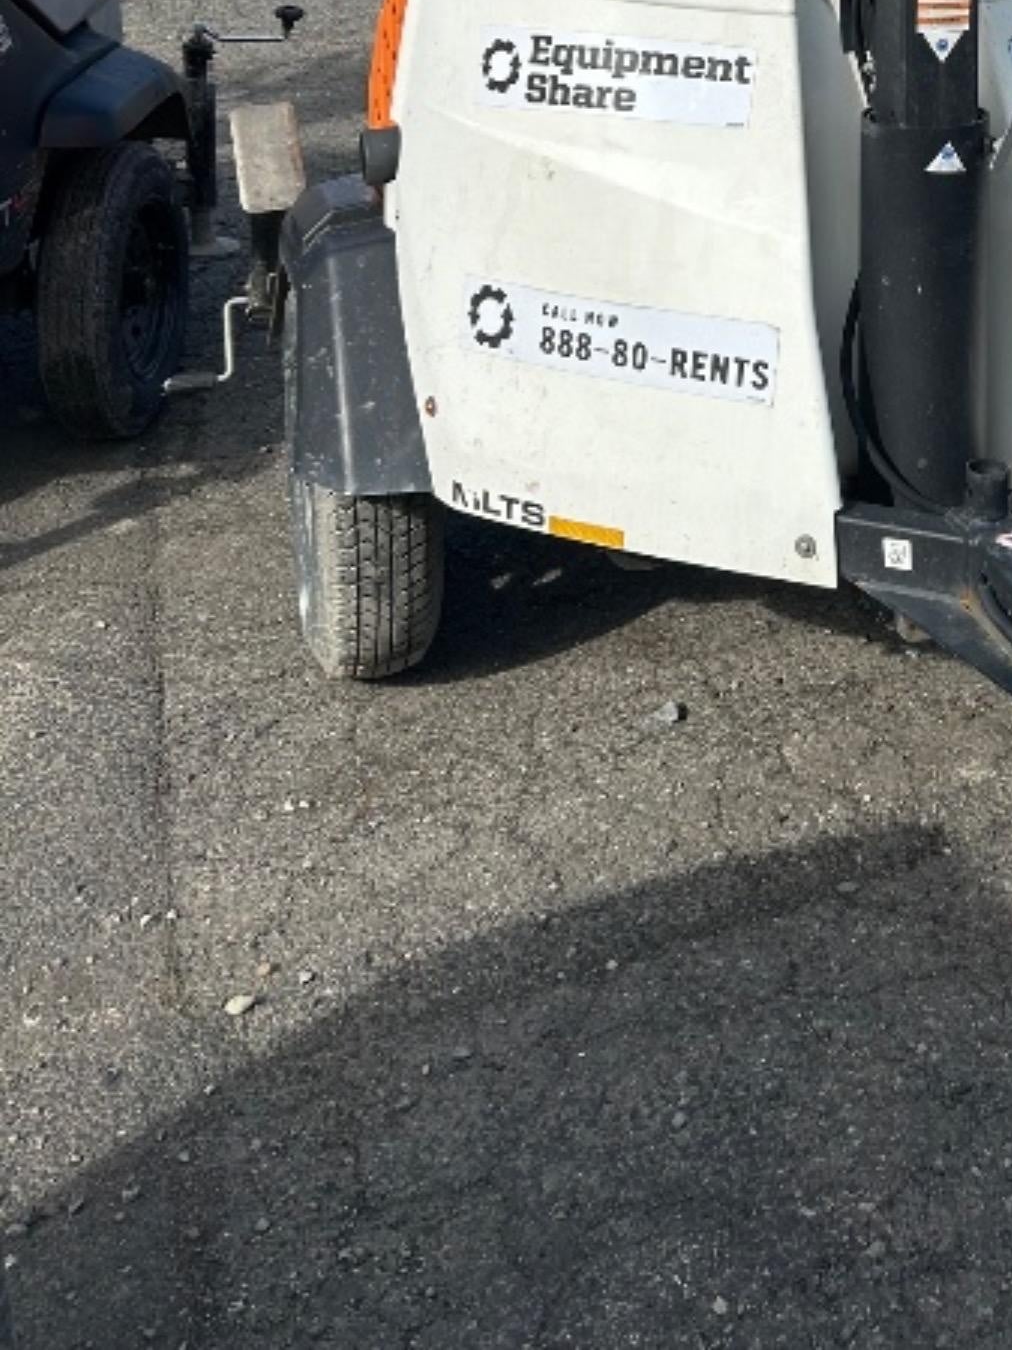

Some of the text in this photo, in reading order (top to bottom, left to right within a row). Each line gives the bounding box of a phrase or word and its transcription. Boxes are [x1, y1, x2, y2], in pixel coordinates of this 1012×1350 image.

[527, 34, 752, 84] Equipment
[524, 72, 637, 112] Share
[538, 326, 770, 391] 888-80-RENTS
